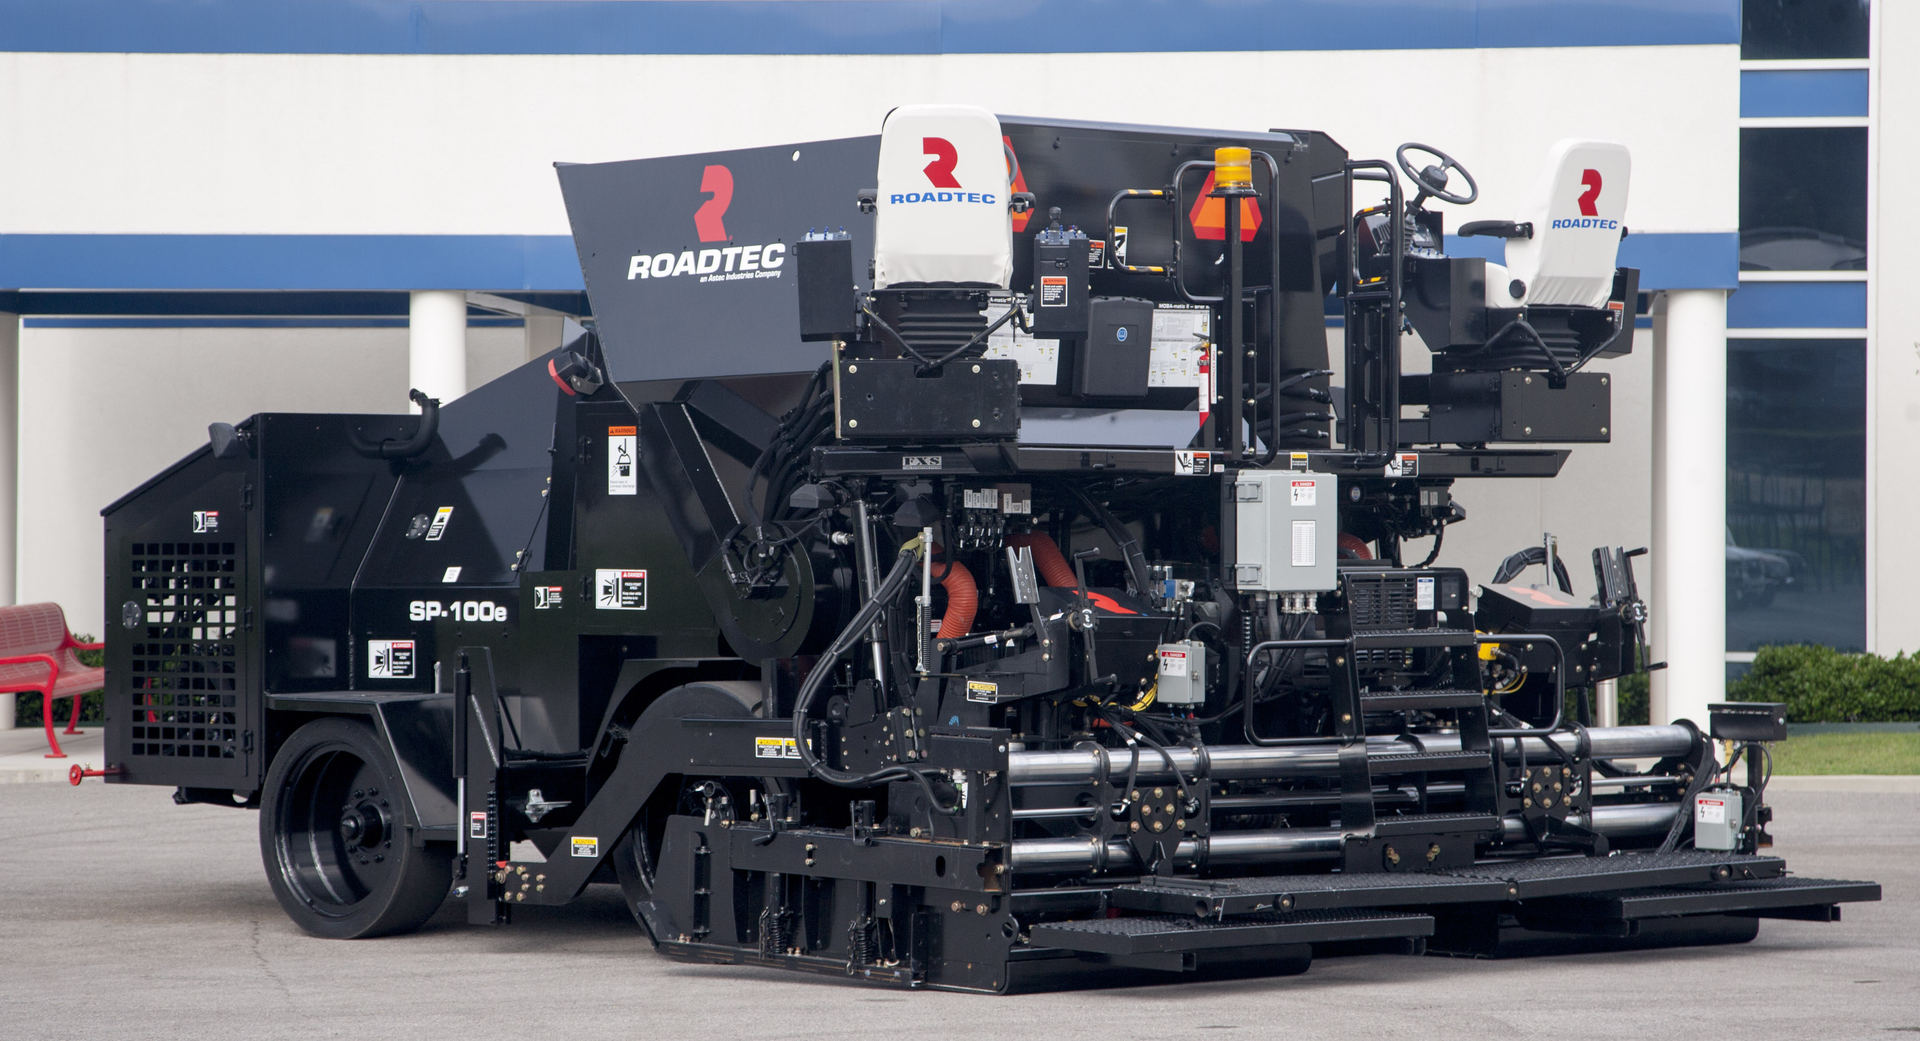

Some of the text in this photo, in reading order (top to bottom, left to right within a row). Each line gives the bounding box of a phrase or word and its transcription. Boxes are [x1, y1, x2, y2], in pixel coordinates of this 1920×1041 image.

[890, 192, 996, 204] ROADTEC
[1552, 218, 1618, 230] ROADTEC
[627, 243, 786, 280] ROADTEC
[708, 274, 725, 282] Astec
[726, 271, 754, 280] Industries
[755, 270, 781, 279] Company
[409, 601, 507, 622] SP-100e
